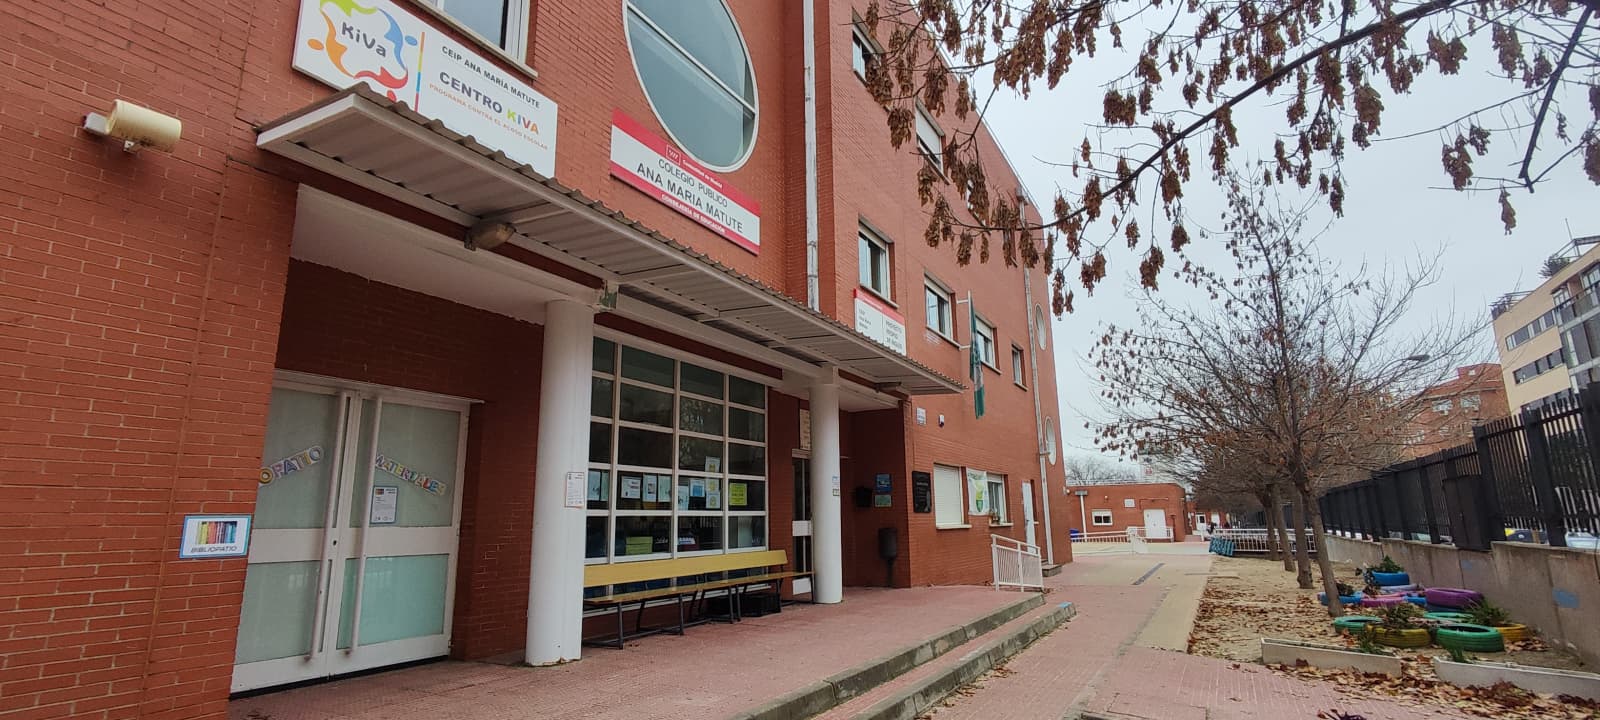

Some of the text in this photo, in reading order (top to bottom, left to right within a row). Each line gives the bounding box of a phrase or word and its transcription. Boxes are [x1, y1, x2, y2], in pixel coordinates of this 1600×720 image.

[342, 21, 386, 57] KiVa
[440, 71, 539, 135] CENTRO KIVA
[442, 45, 462, 61] CEIP
[464, 59, 481, 75] ANA
[510, 86, 540, 109] MATUTE
[637, 162, 744, 234] ANA MARIA MATUTE
[658, 158, 695, 187] COLEGIO
